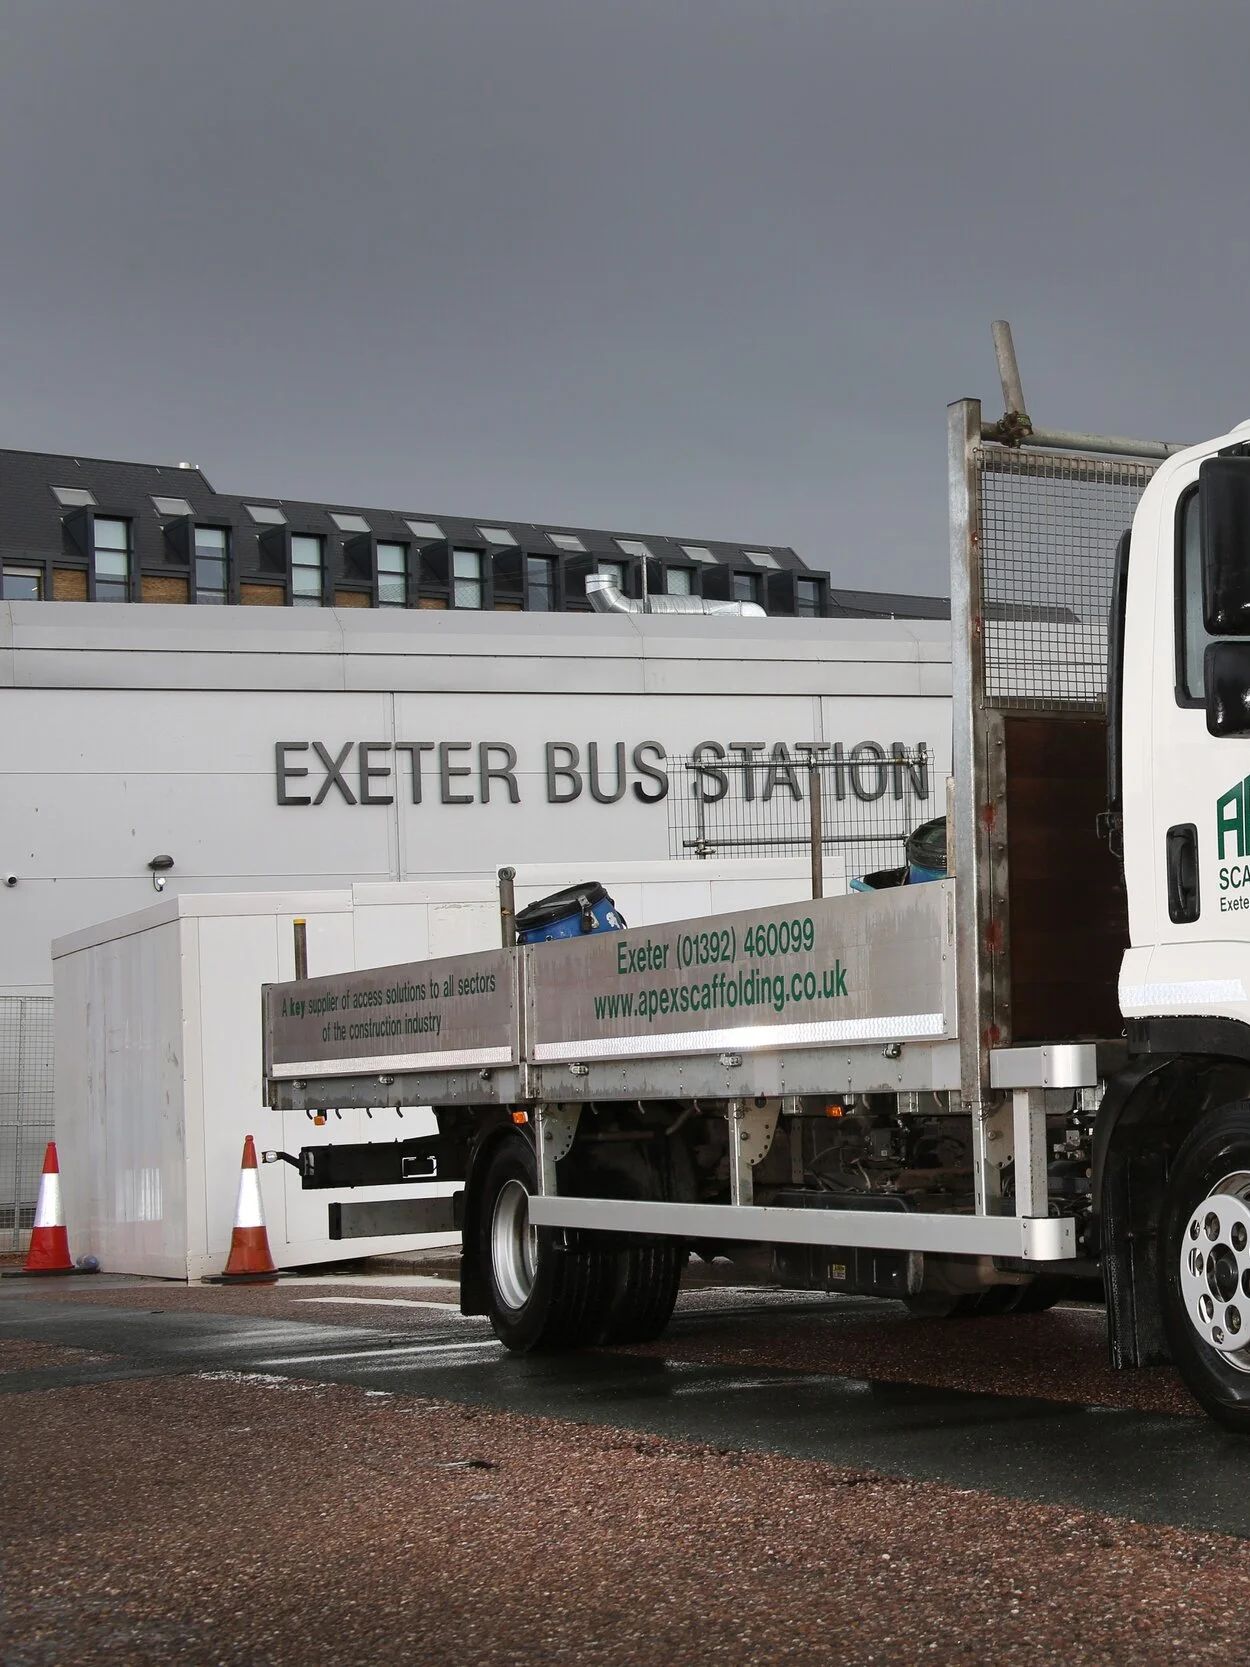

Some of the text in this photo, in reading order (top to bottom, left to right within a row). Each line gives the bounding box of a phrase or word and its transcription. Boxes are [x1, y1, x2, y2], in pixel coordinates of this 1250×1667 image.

[275, 740, 929, 806] EXETER BUS STATION
[617, 917, 815, 975] Exeter (01392) 460099
[281, 972, 496, 1019] A key supplier of access solutions to all sectors
[594, 959, 848, 1022] www.apexscaffolding.co.uk
[322, 1013, 441, 1042] of the construction industry
